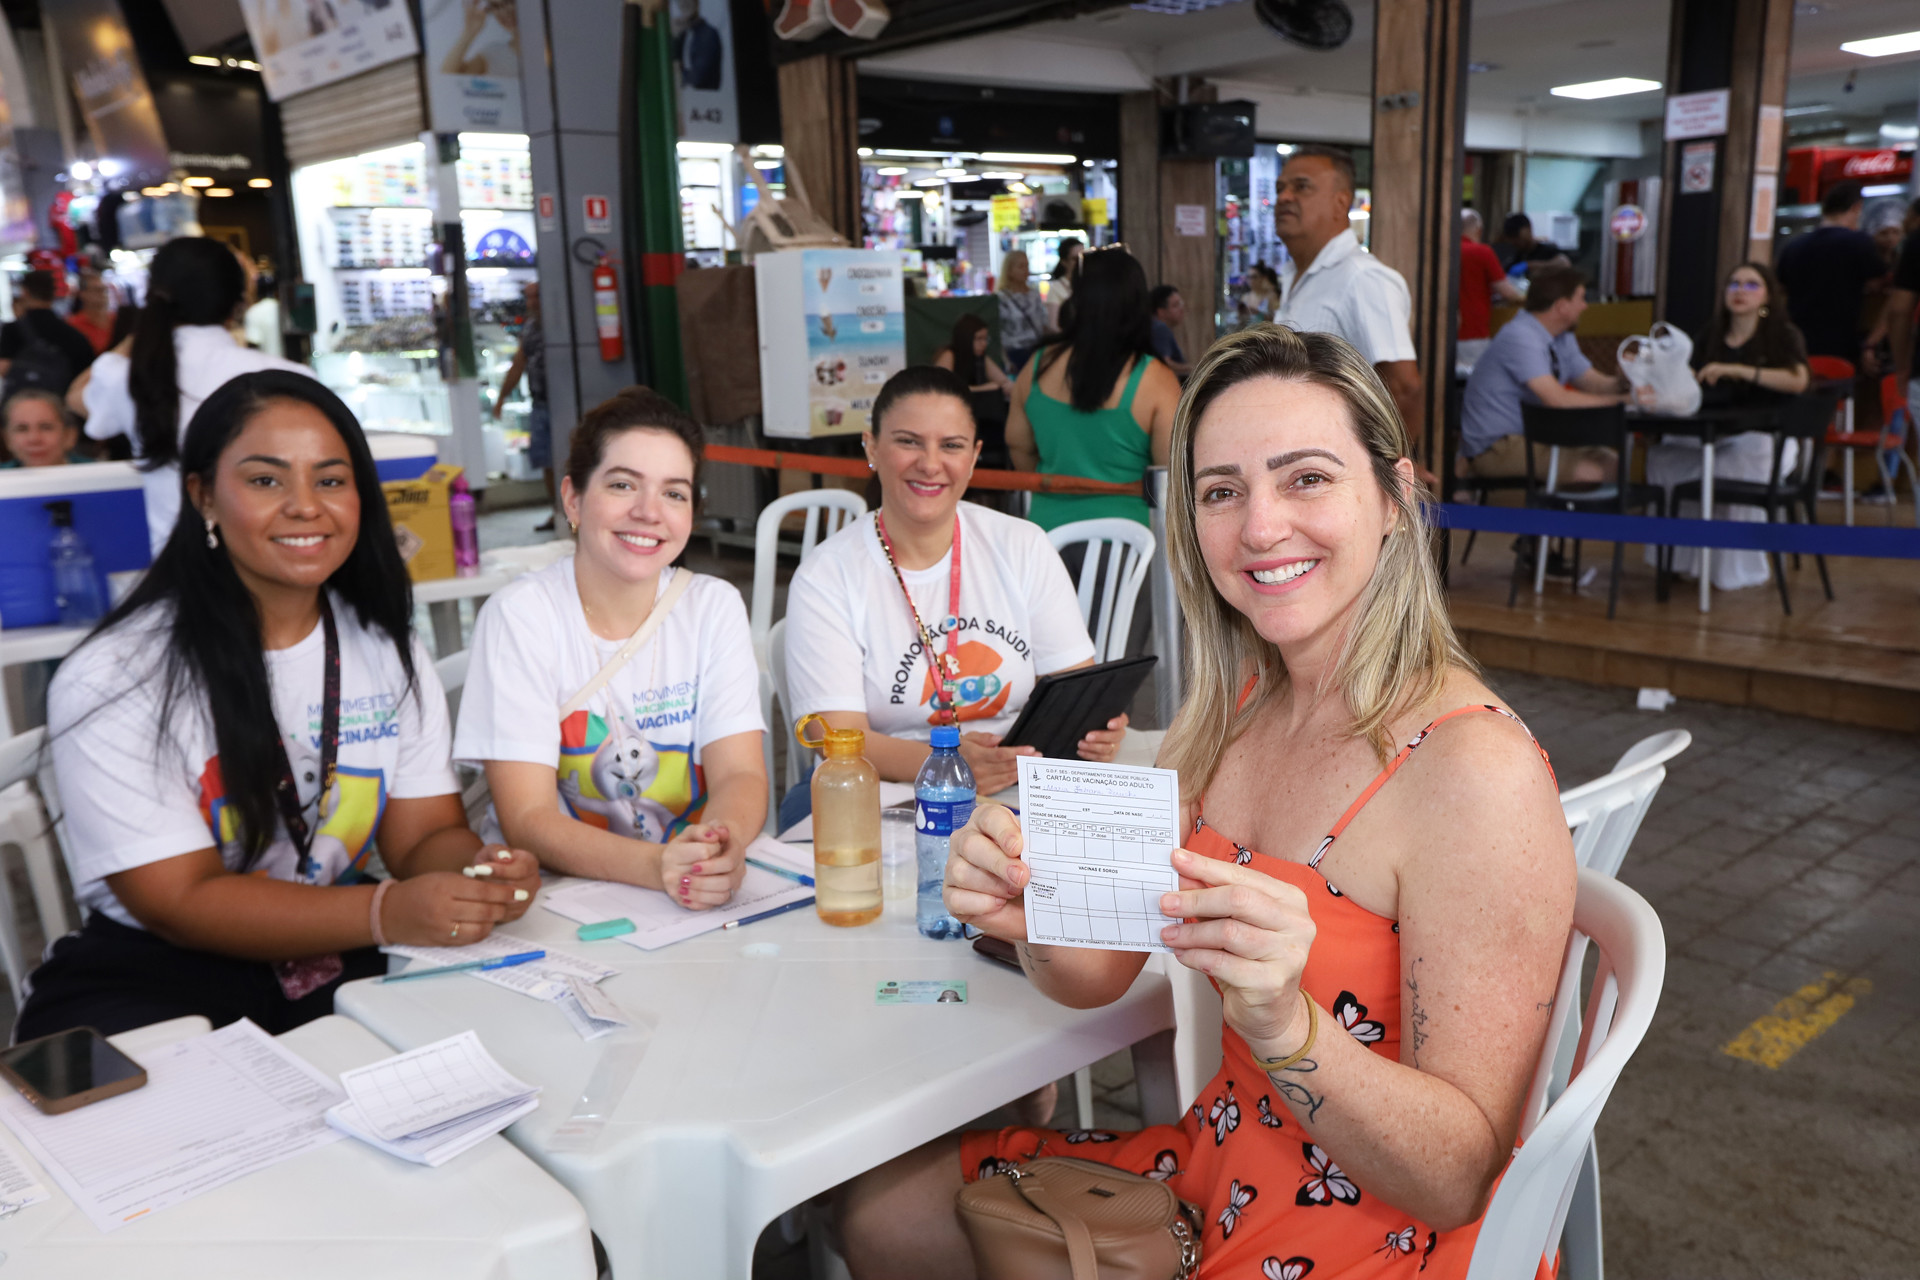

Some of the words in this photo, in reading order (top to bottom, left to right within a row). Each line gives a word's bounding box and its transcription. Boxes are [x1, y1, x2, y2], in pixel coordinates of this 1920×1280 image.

[957, 617, 980, 631] DA
[984, 619, 1032, 662] SAÚDE
[1082, 778, 1117, 786] VACINAÇÃO
[1406, 961, 1428, 1066] gratidão
